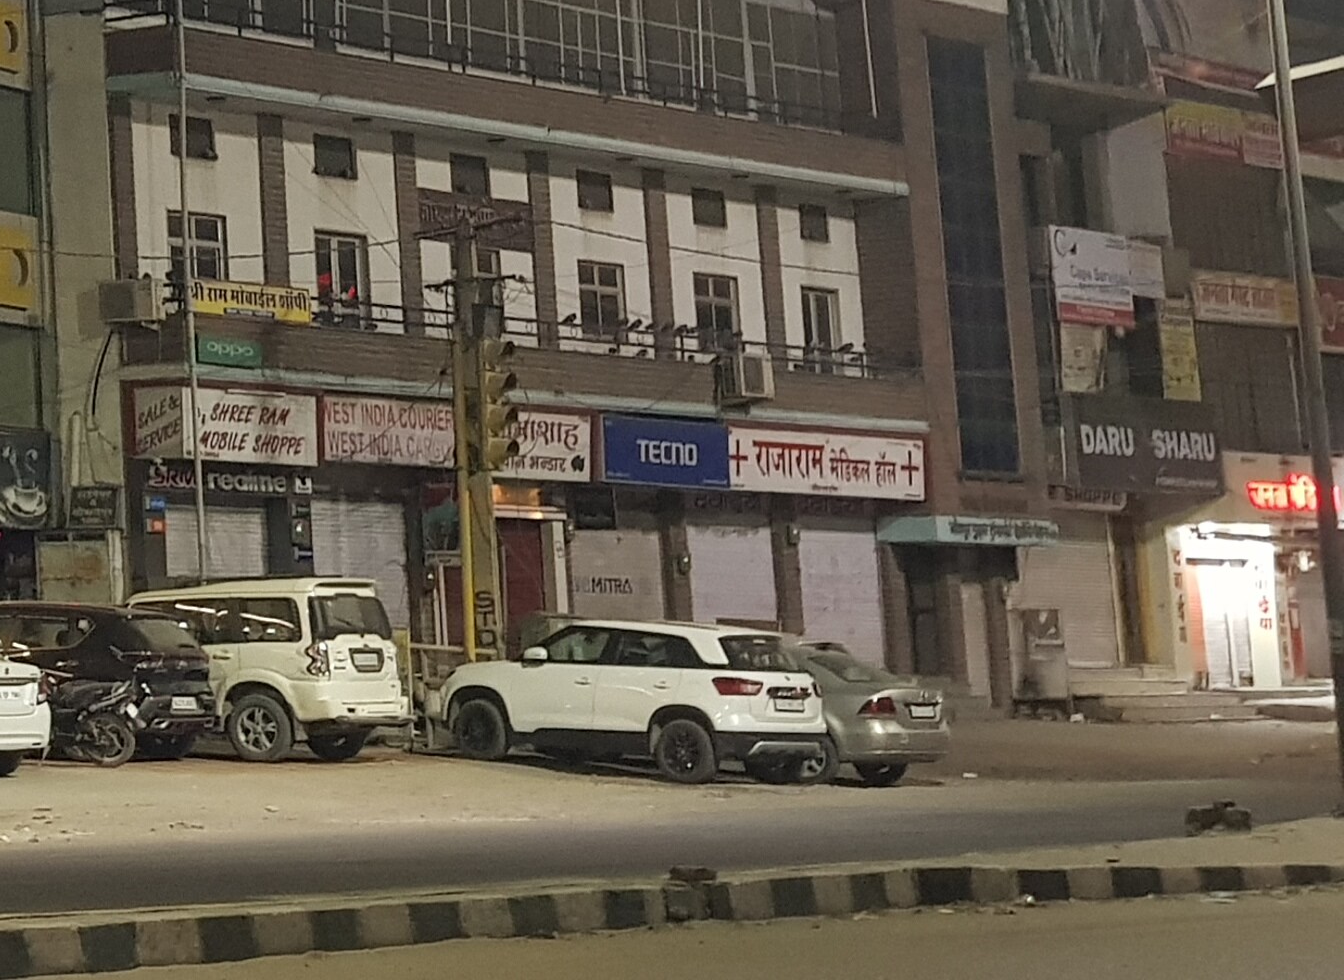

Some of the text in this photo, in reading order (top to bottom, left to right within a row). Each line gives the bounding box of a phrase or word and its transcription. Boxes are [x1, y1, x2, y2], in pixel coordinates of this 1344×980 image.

[138, 403, 166, 430] SALE
[210, 402, 291, 427] SHREE RAM
[362, 403, 396, 428] INDIA
[199, 431, 305, 457] MOBILE SHOPPE
[327, 431, 365, 455] WEST
[368, 433, 403, 459] INDIA
[636, 438, 698, 466] TECNO
[1080, 424, 1216, 461] DARU SHARU
[752, 440, 897, 487] राजाराम मेडिकल हॉल
[476, 590, 496, 646] STO
